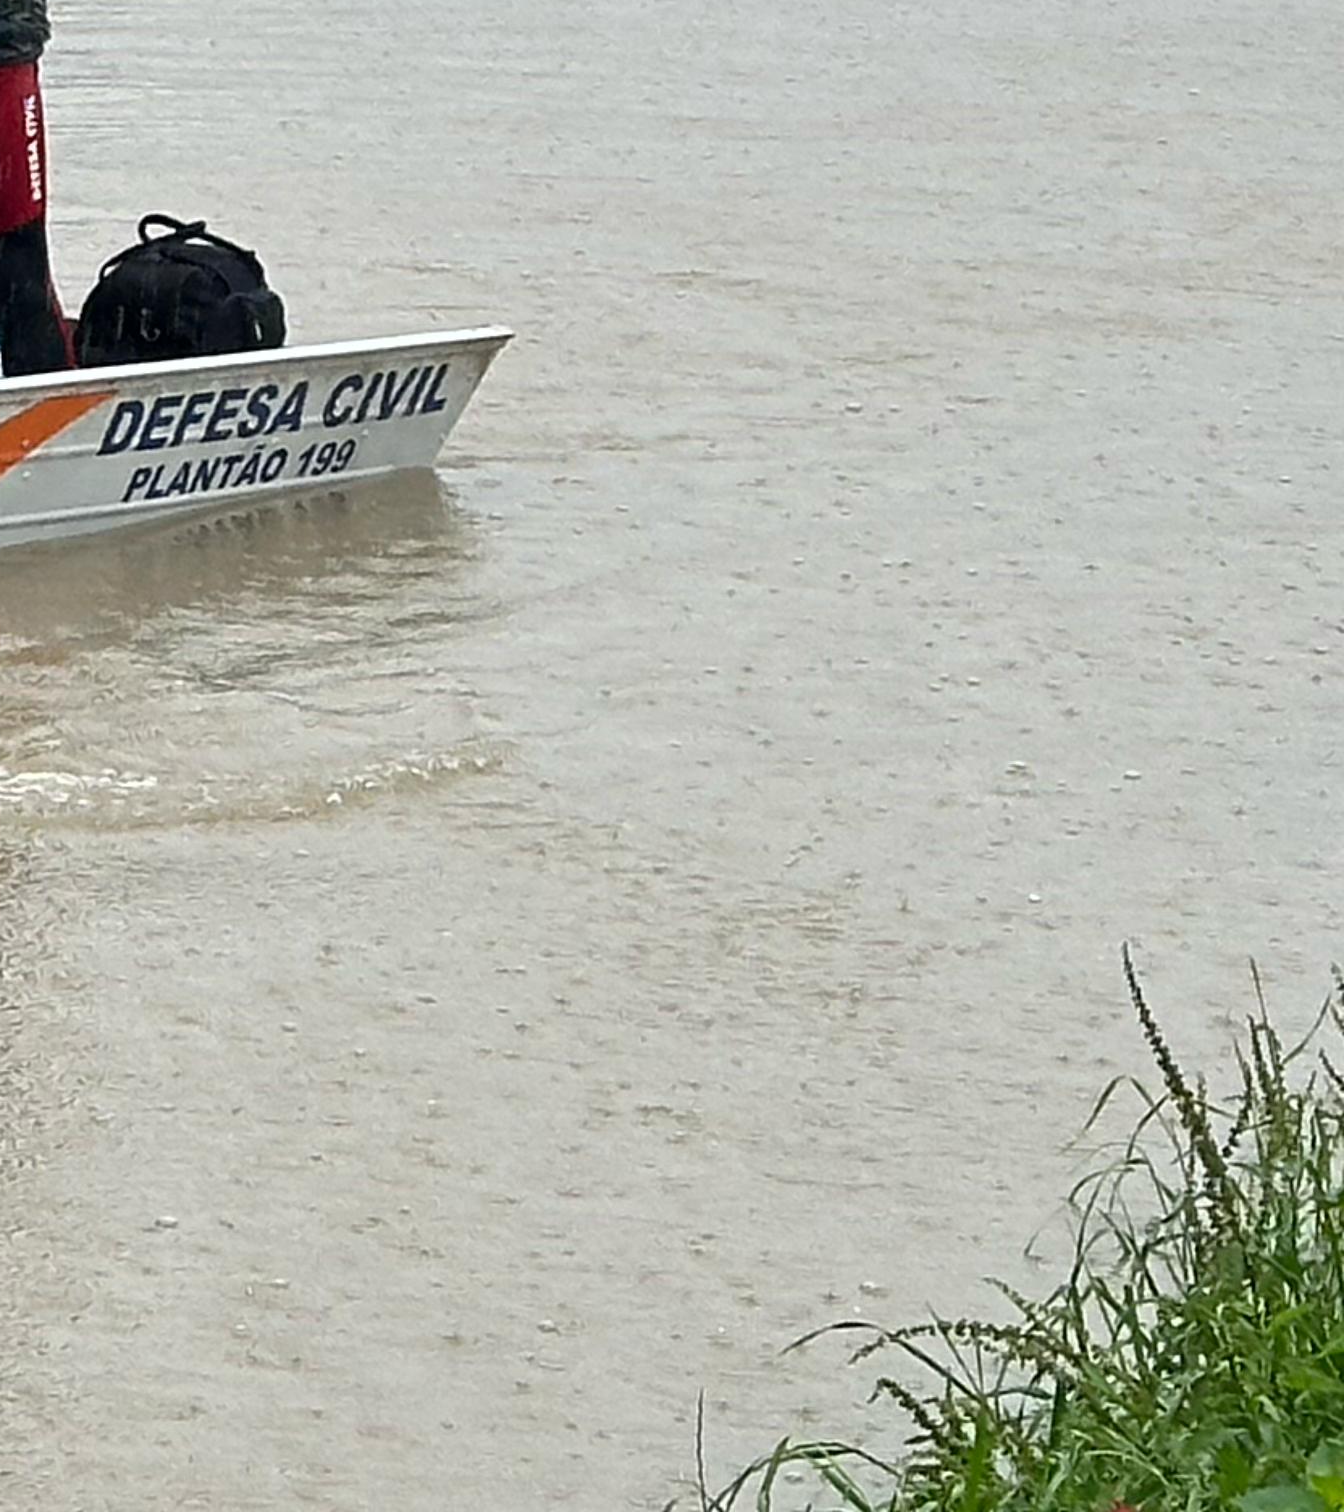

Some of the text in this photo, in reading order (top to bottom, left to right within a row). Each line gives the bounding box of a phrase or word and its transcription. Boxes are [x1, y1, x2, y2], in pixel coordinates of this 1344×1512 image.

[96, 362, 450, 456] DEFESA CIVIL
[122, 438, 357, 503] PLANTÃO 199
